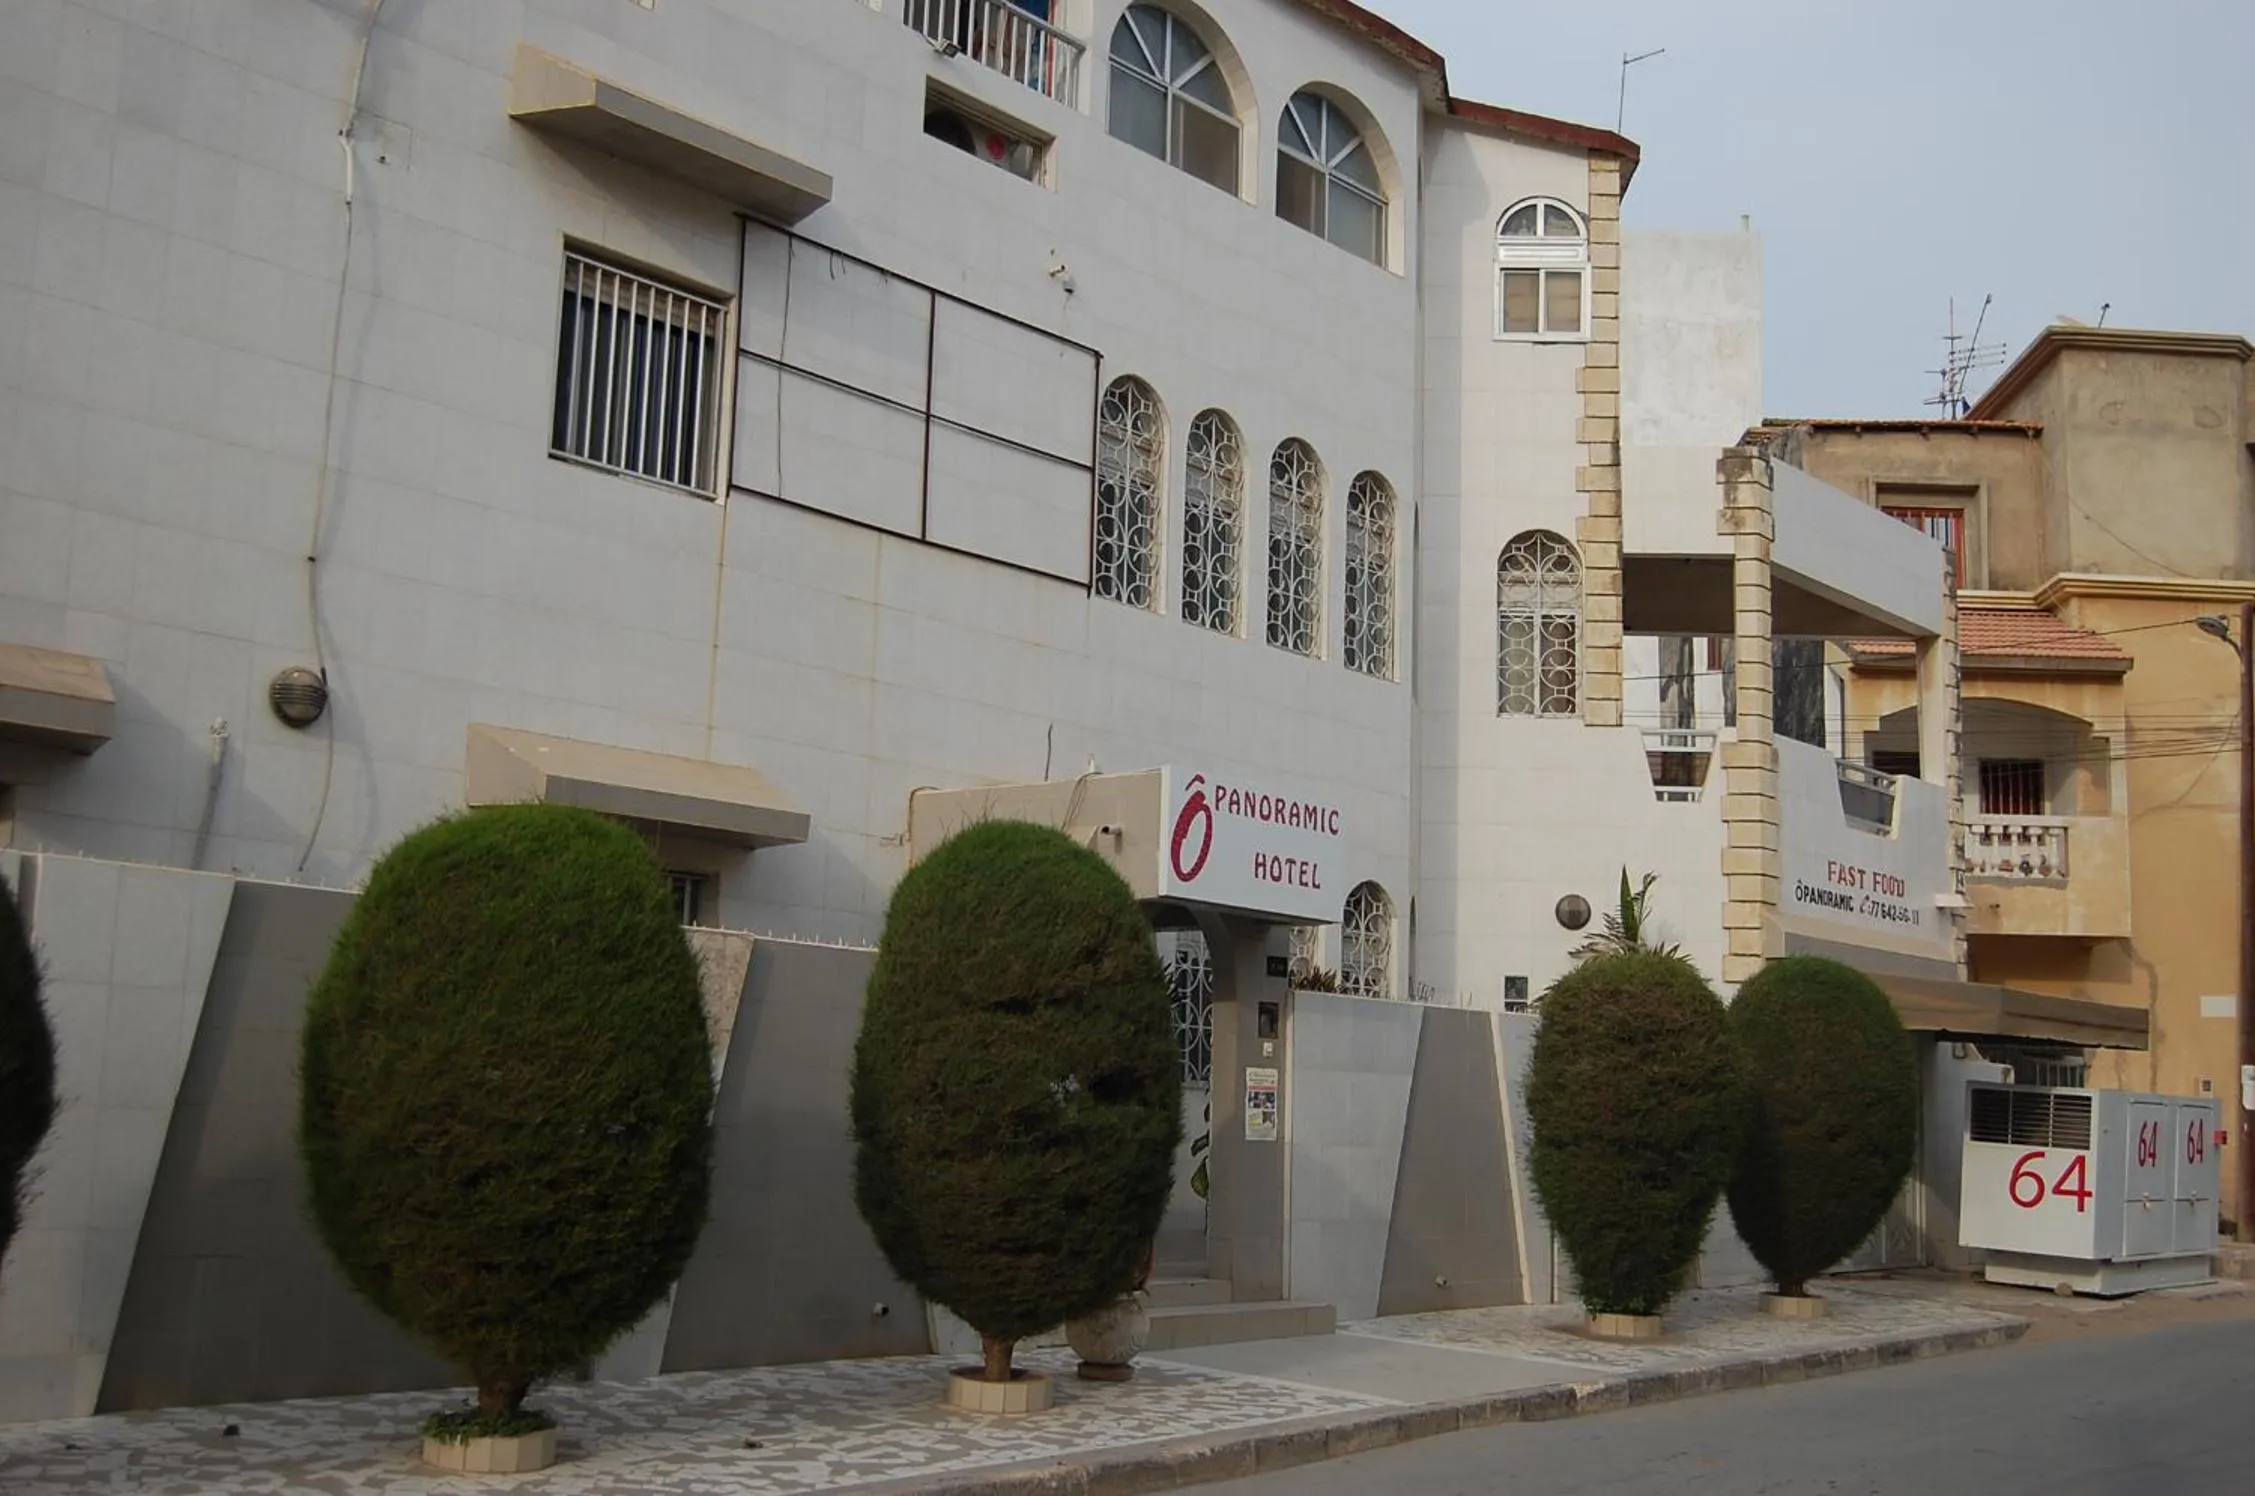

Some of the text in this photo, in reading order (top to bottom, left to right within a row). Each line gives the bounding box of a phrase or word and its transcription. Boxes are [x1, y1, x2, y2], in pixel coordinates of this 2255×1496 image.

[1215, 785, 1340, 836] PANORAMIC
[1254, 852, 1321, 889] HOTEL
[1827, 860, 1905, 898] FAST FOOD
[2137, 1121, 2158, 1168] 64
[2187, 1118, 2203, 1165] 64
[2009, 1151, 2093, 1212] 64
